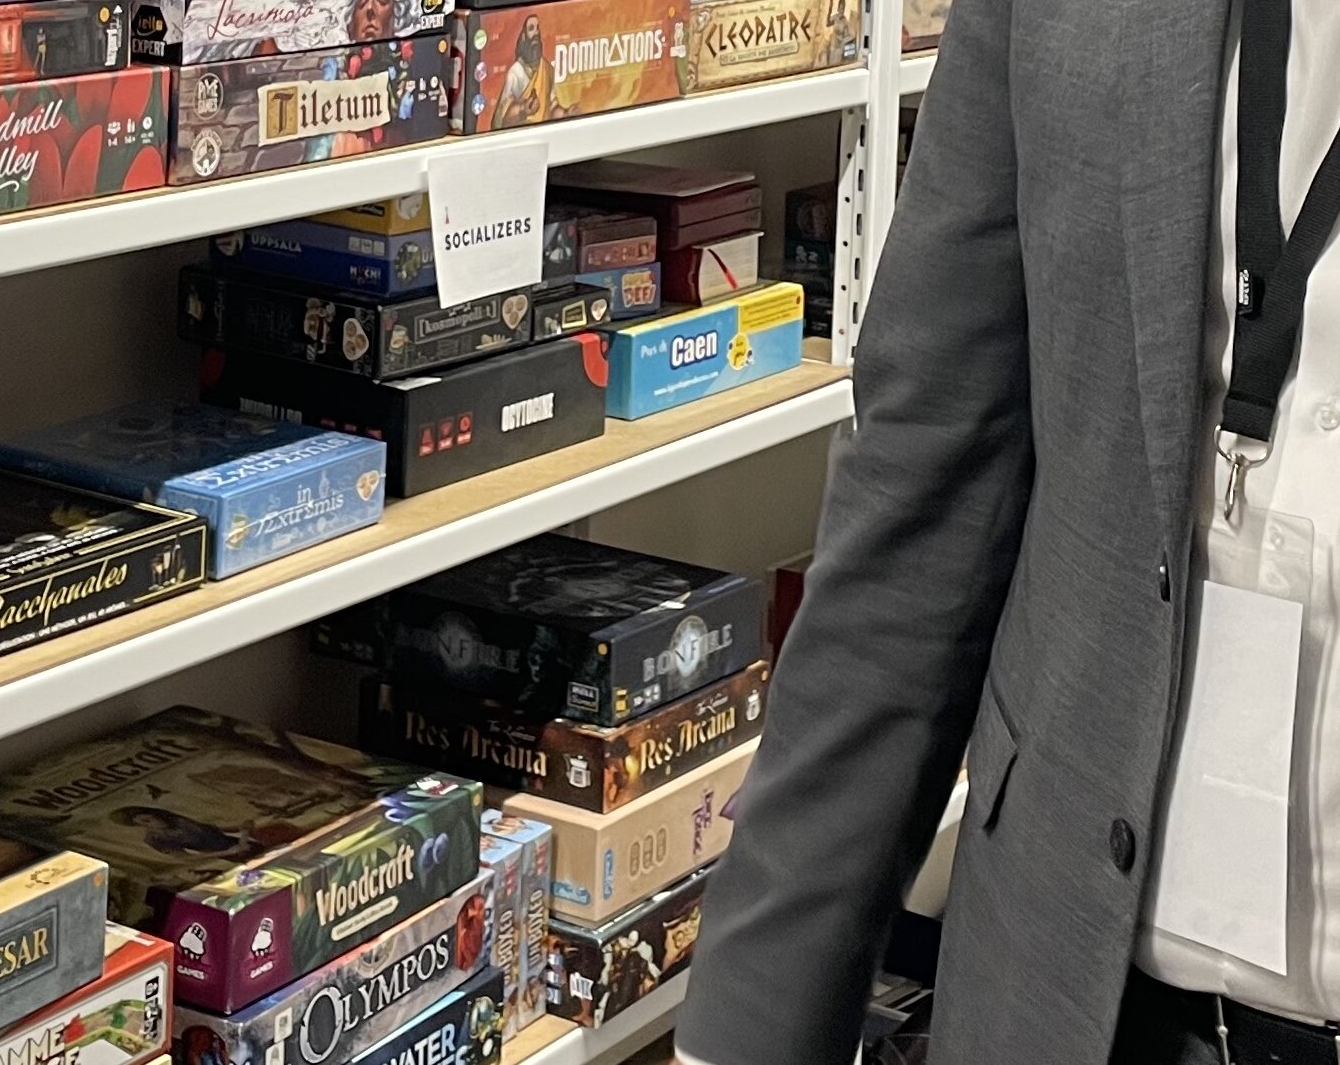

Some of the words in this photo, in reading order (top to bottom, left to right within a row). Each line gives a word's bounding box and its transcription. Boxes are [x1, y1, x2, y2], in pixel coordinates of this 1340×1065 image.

[420, 13, 445, 29] EXPERT
[704, 10, 812, 58] CLEOPATRE
[131, 39, 166, 57] EXPERT
[555, 29, 663, 84] DOMINATIONS
[266, 86, 383, 136] Tiletum
[251, 234, 302, 253] UPPSALA
[444, 217, 531, 251] SOCIALIZERS
[672, 332, 717, 367] Caen
[641, 622, 734, 683] BONFIRE
[405, 710, 451, 752] Res
[462, 724, 549, 778] Arcana
[640, 738, 674, 775] Res
[678, 704, 737, 762] Arcana
[13, 738, 202, 814] Woodcraft
[315, 841, 416, 927] Woodcraft
[175, 964, 206, 981] GAMES
[249, 960, 275, 980] GAMES
[299, 935, 450, 1065] OLYMPOS
